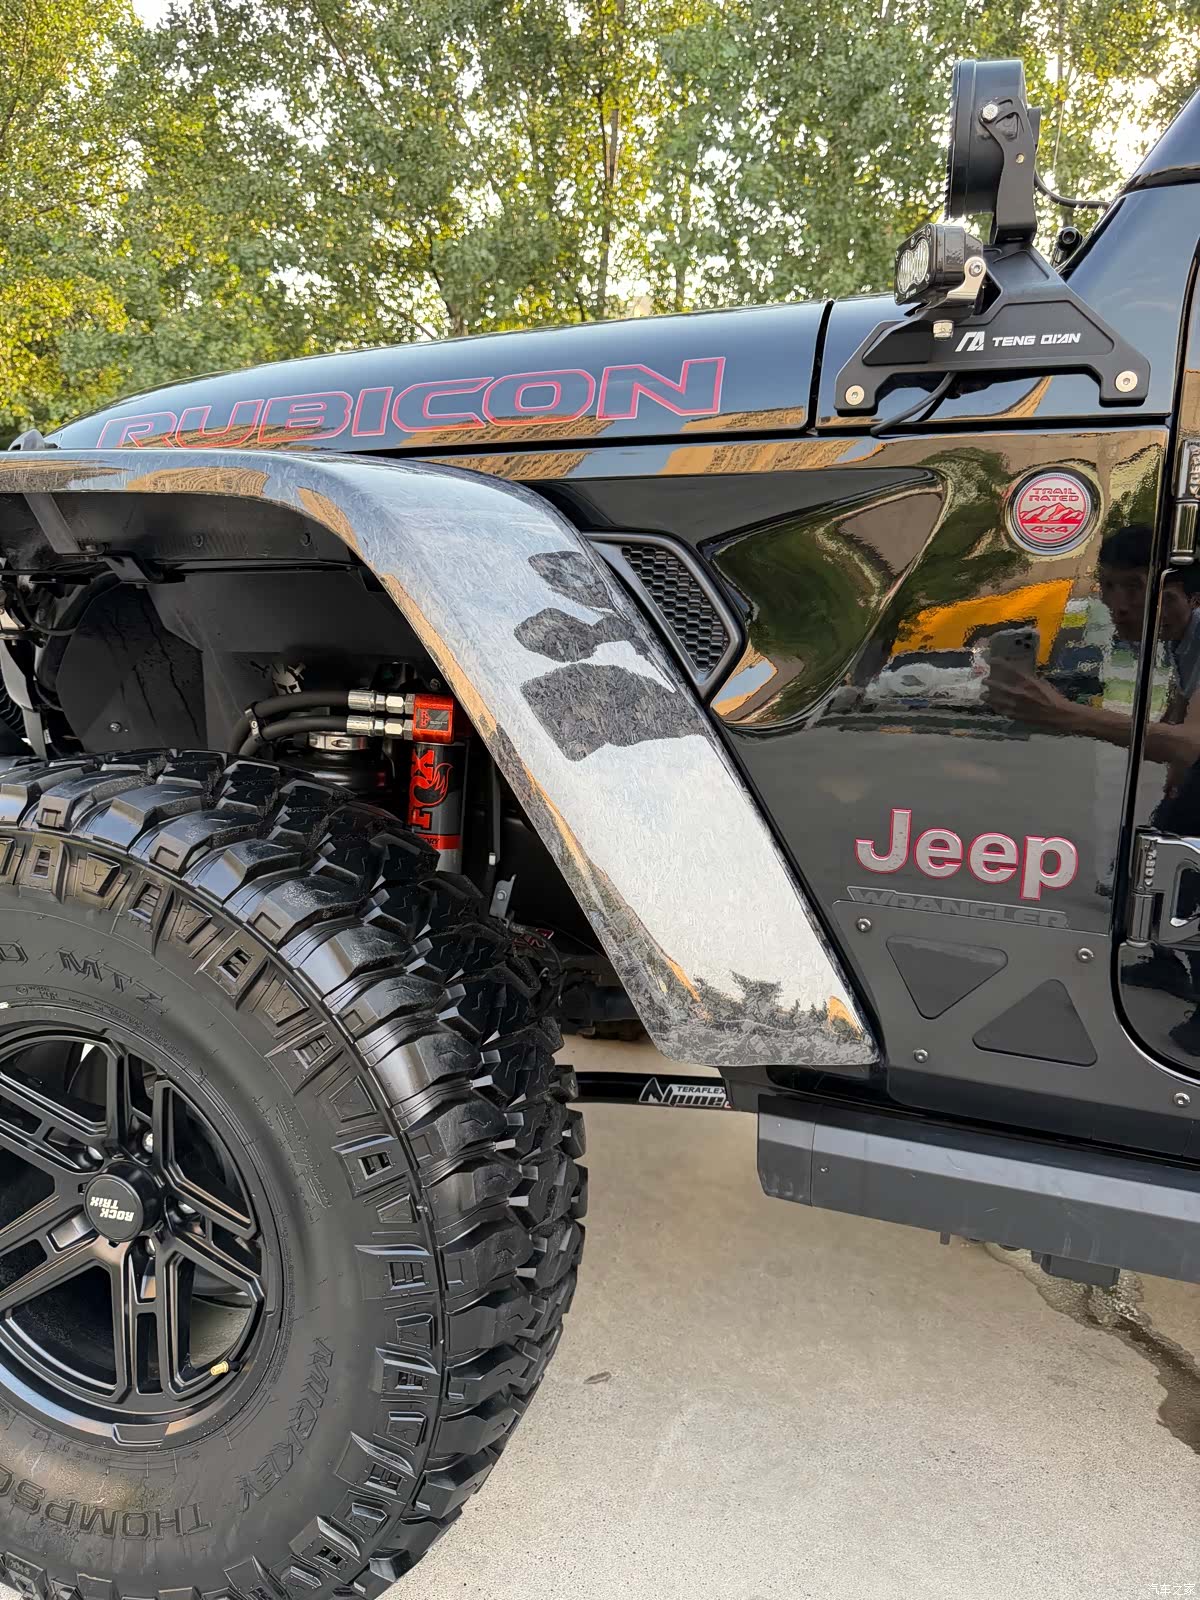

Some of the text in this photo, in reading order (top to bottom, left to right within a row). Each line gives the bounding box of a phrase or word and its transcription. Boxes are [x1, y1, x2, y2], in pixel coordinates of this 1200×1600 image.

[992, 335, 1036, 347] TENG
[97, 356, 726, 449] RUBICON
[1032, 487, 1077, 495] TRAIL
[855, 808, 1079, 901] Jeep
[853, 889, 1069, 928] WRANGLER
[677, 1085, 727, 1095] TERAFLEX
[100, 1208, 134, 1222] ROCK
